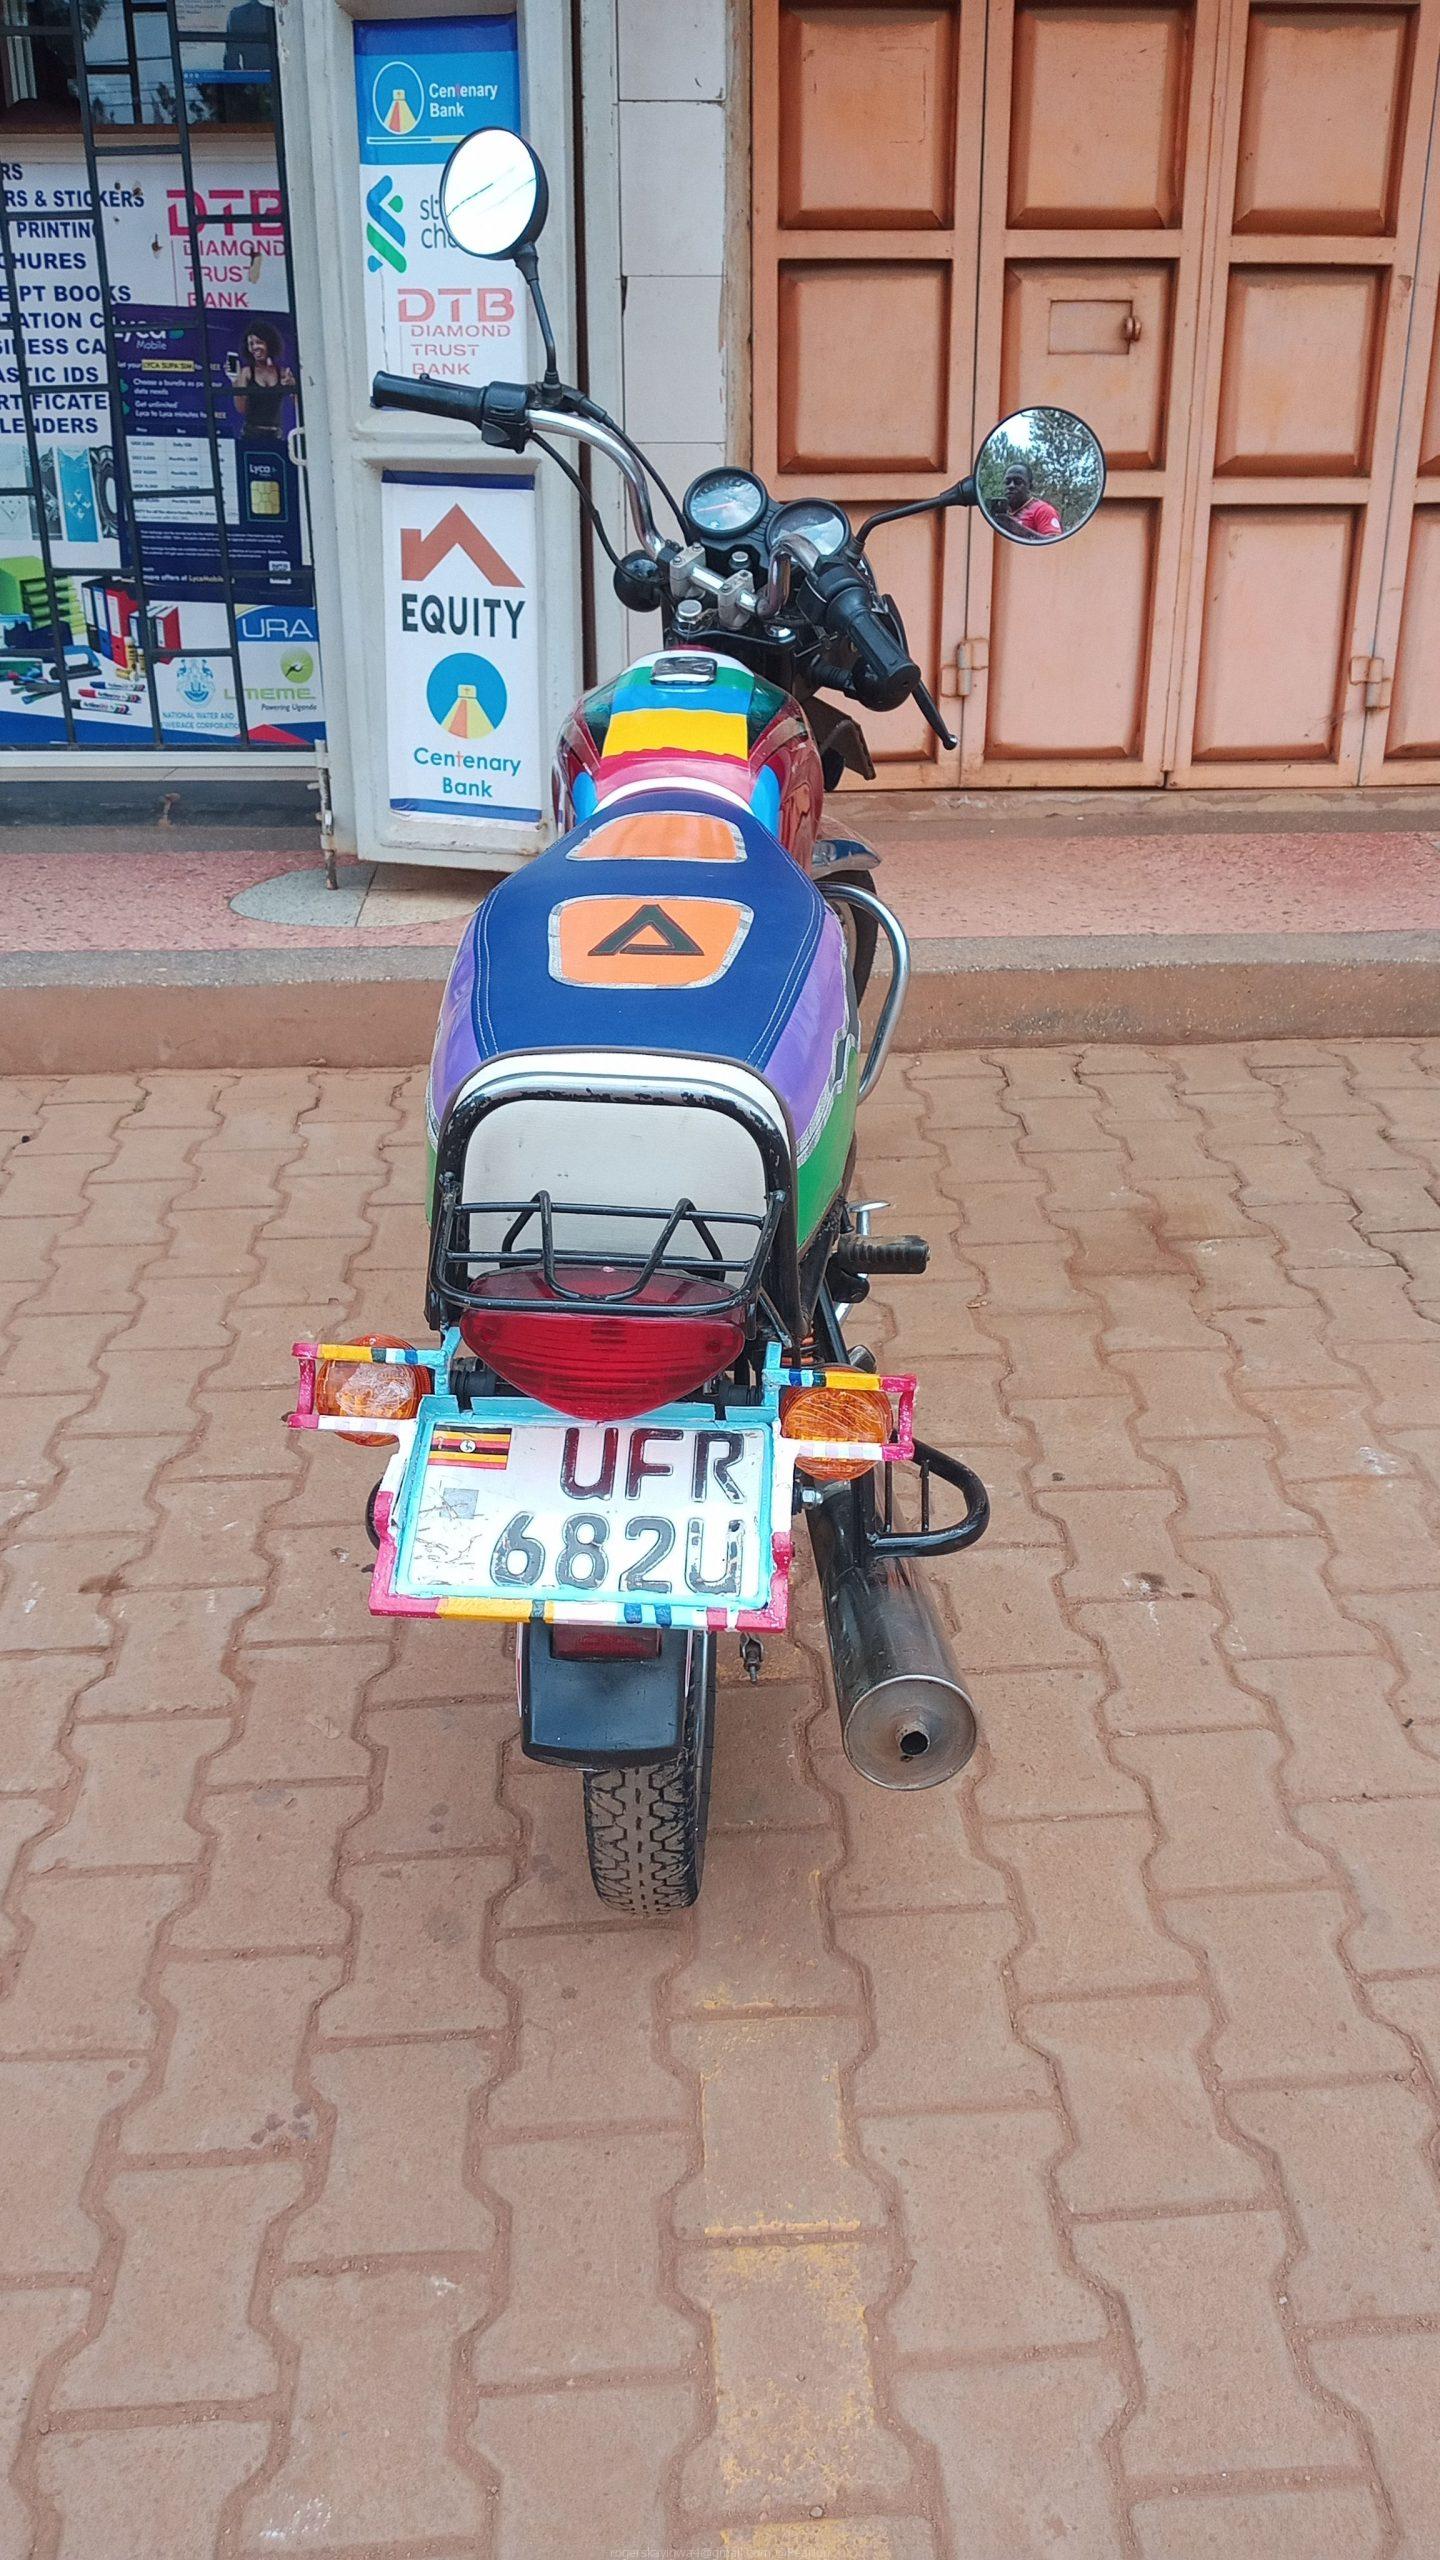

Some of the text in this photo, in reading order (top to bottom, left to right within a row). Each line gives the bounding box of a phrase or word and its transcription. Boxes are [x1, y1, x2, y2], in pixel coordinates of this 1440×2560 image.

[428, 82, 499, 101] Centenary
[429, 101, 465, 118] Bank
[34, 190, 47, 208] &
[53, 190, 145, 208] STICKERS
[420, 194, 440, 220] st
[166, 189, 286, 236] DTB
[16, 221, 96, 239] PRINTIN
[183, 239, 287, 257] DIAMOND
[54, 285, 132, 303] BOOKS
[397, 287, 516, 323] DTB
[410, 324, 511, 338] DIAMOND
[410, 343, 480, 357] TRUST
[63, 366, 99, 383] IDS
[412, 362, 471, 376] BANK
[0, 394, 108, 411] RTFICATE
[401, 593, 526, 639] EQUITY
[242, 618, 314, 639] URA
[261, 703, 318, 714] Powering Uganda
[413, 747, 522, 777] Centenary
[442, 777, 494, 798] Bank
[559, 1426, 746, 1504] UFR
[489, 1511, 745, 1597] 682U
